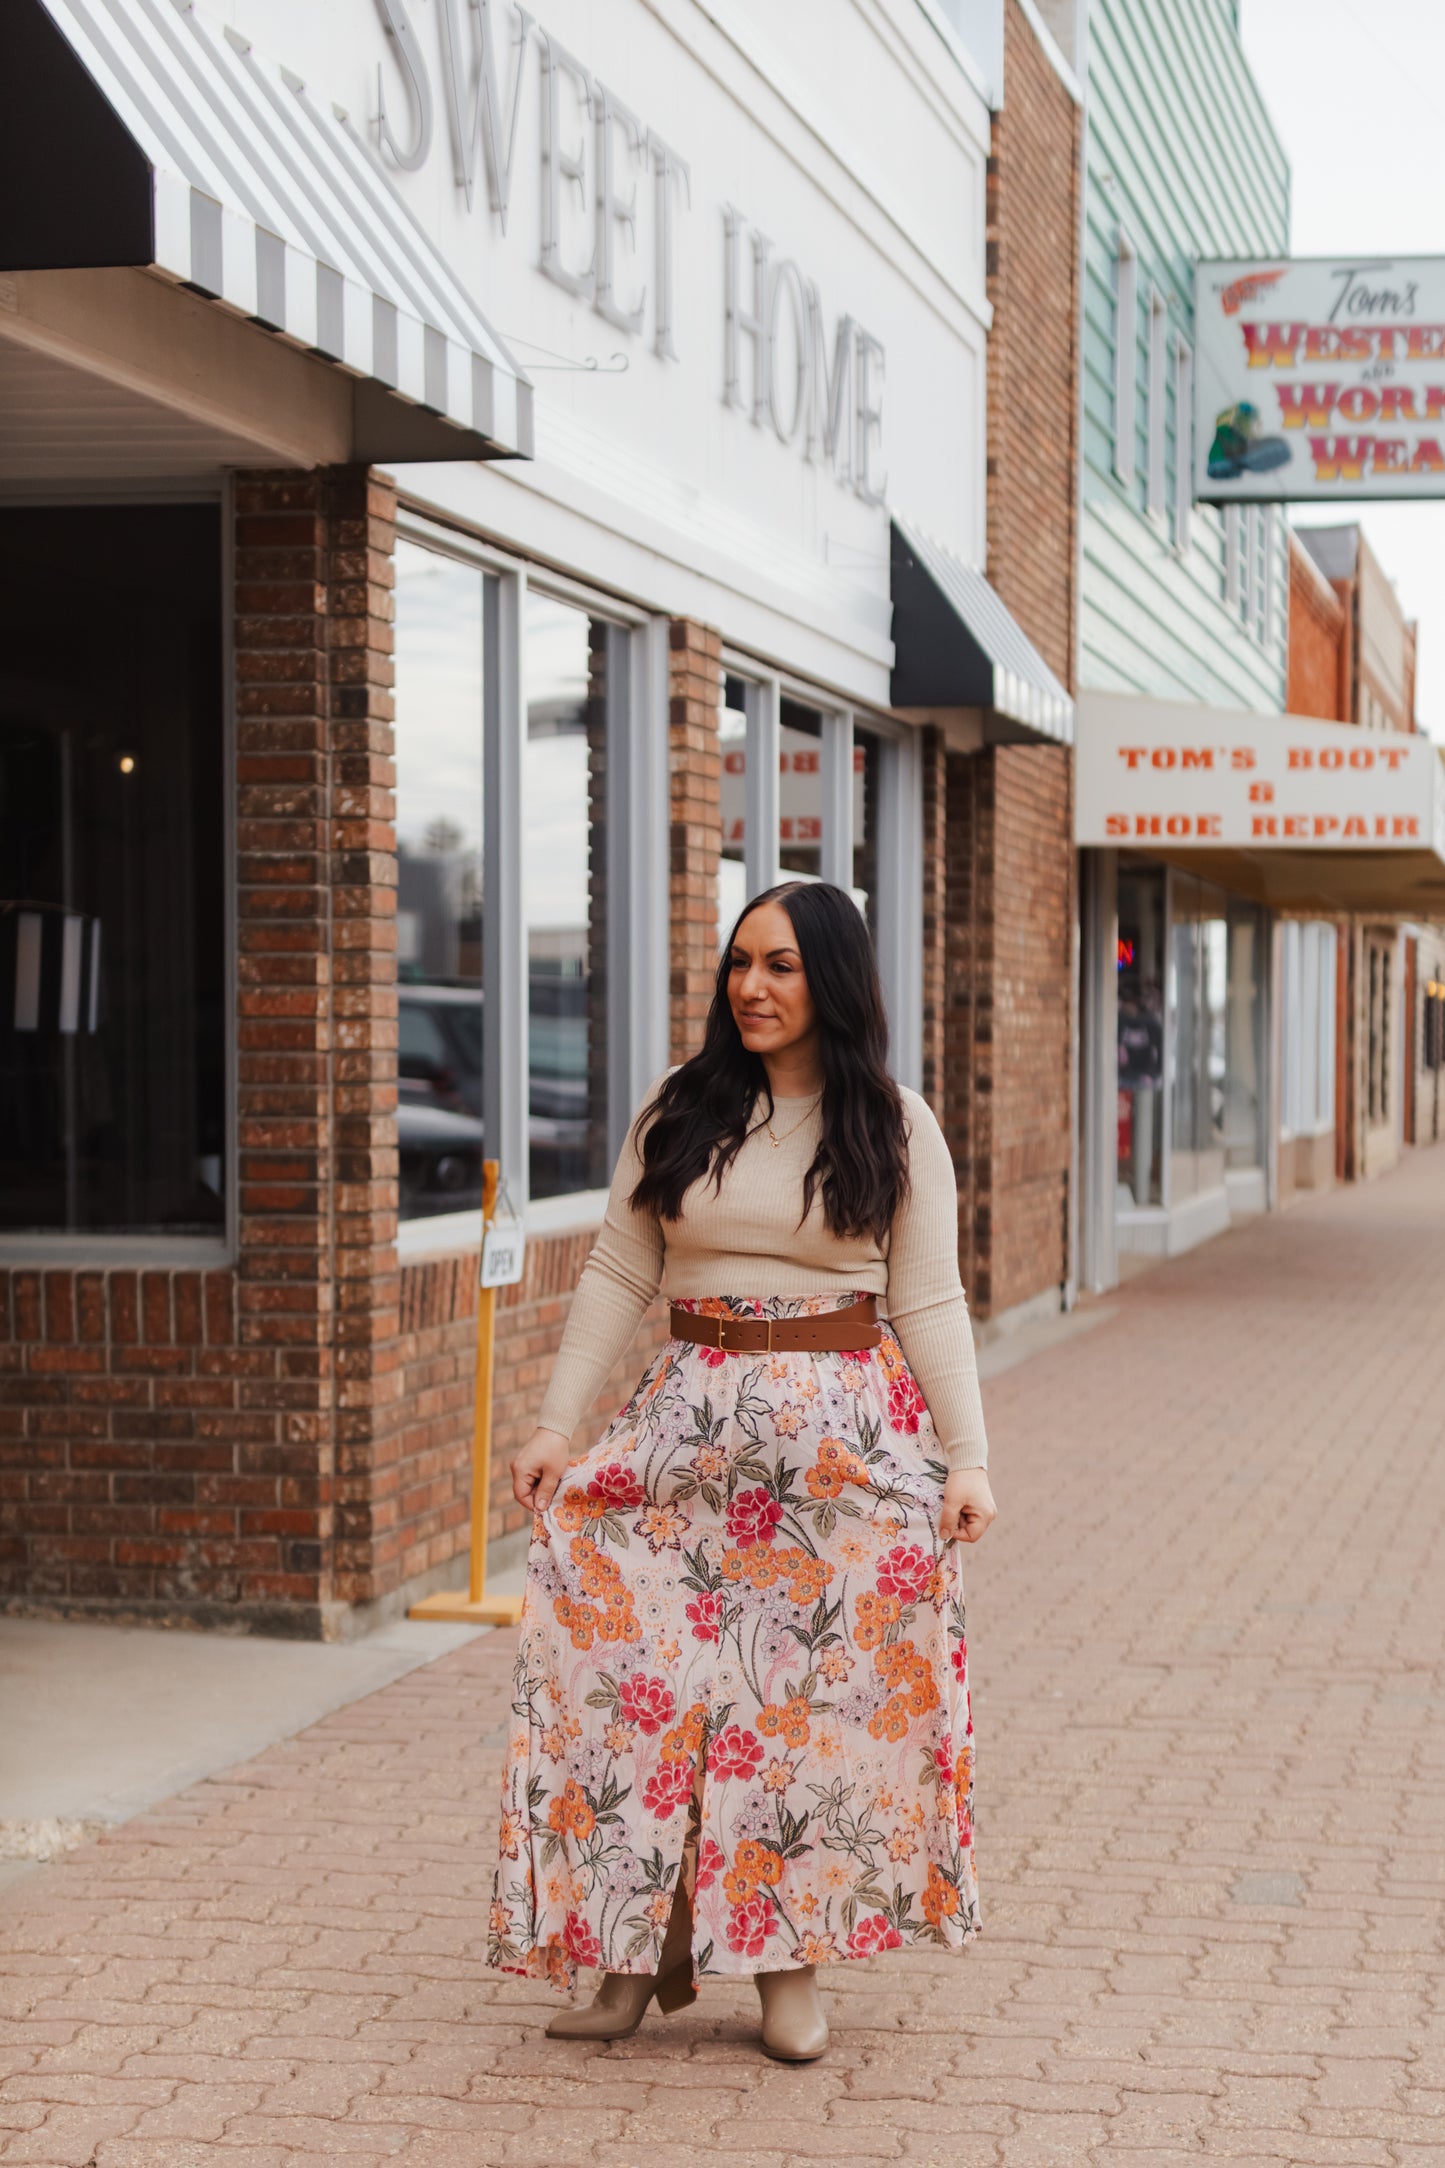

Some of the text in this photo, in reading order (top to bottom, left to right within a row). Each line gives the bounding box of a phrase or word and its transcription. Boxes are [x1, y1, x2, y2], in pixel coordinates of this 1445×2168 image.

[721, 202, 888, 508] HOME
[1118, 747, 1410, 771] TOM'S BOOT
[1105, 815, 1419, 838] SHOE REPAIR
[488, 1247, 514, 1277] OPEN
